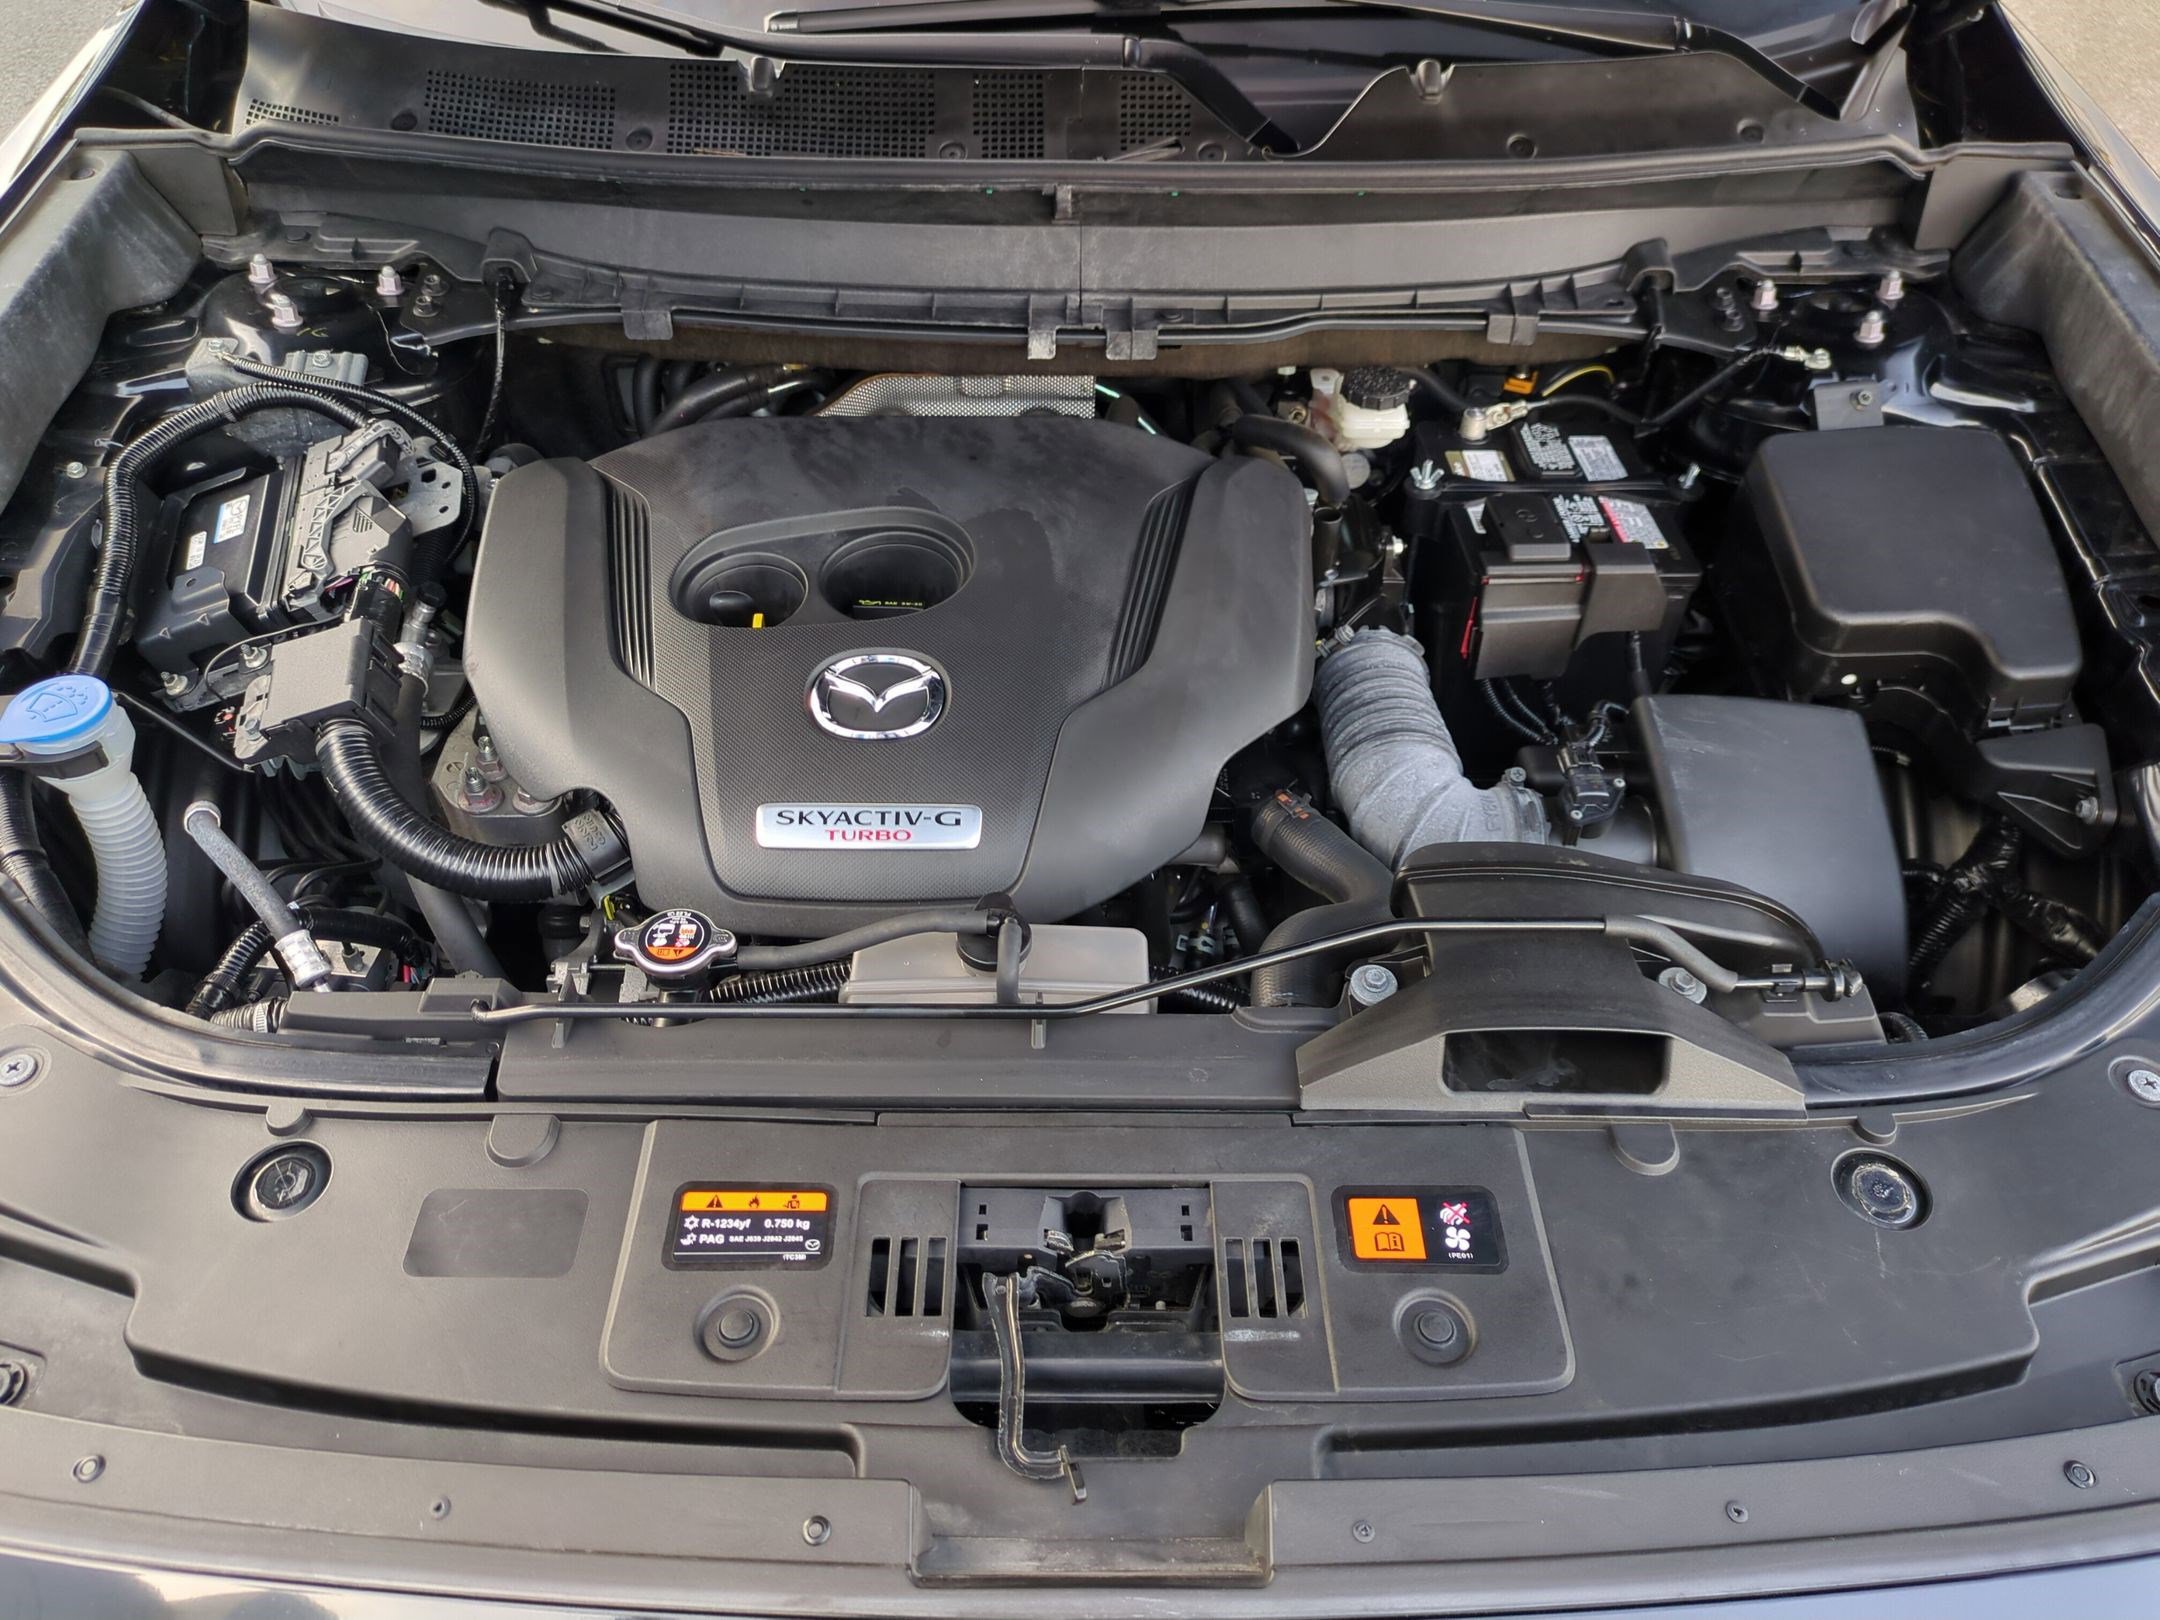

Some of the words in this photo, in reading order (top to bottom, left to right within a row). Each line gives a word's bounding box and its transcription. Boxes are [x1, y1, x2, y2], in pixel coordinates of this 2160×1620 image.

[776, 810, 962, 826] SKYACTIV-G
[825, 830, 912, 842] TURBO
[701, 1218, 751, 1230] R-1234yf
[764, 1218, 794, 1229] 0.750
[796, 1218, 810, 1230] kg
[699, 1234, 725, 1244] PAG
